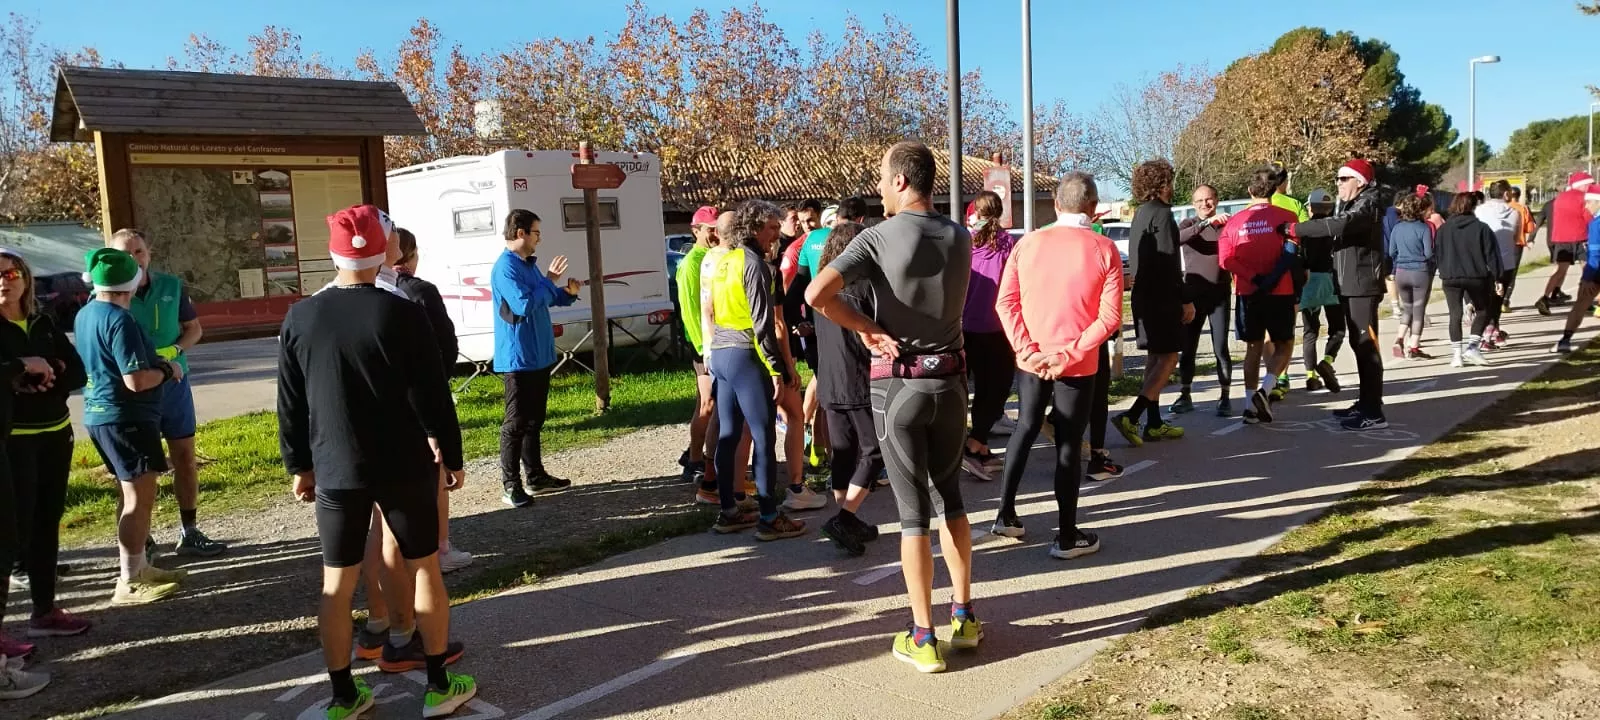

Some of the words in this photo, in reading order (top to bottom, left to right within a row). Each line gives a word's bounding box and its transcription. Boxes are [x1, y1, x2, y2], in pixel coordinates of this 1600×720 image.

[129, 143, 159, 151] Camino
[160, 143, 188, 151] Natural
[201, 144, 226, 152] Loreto
